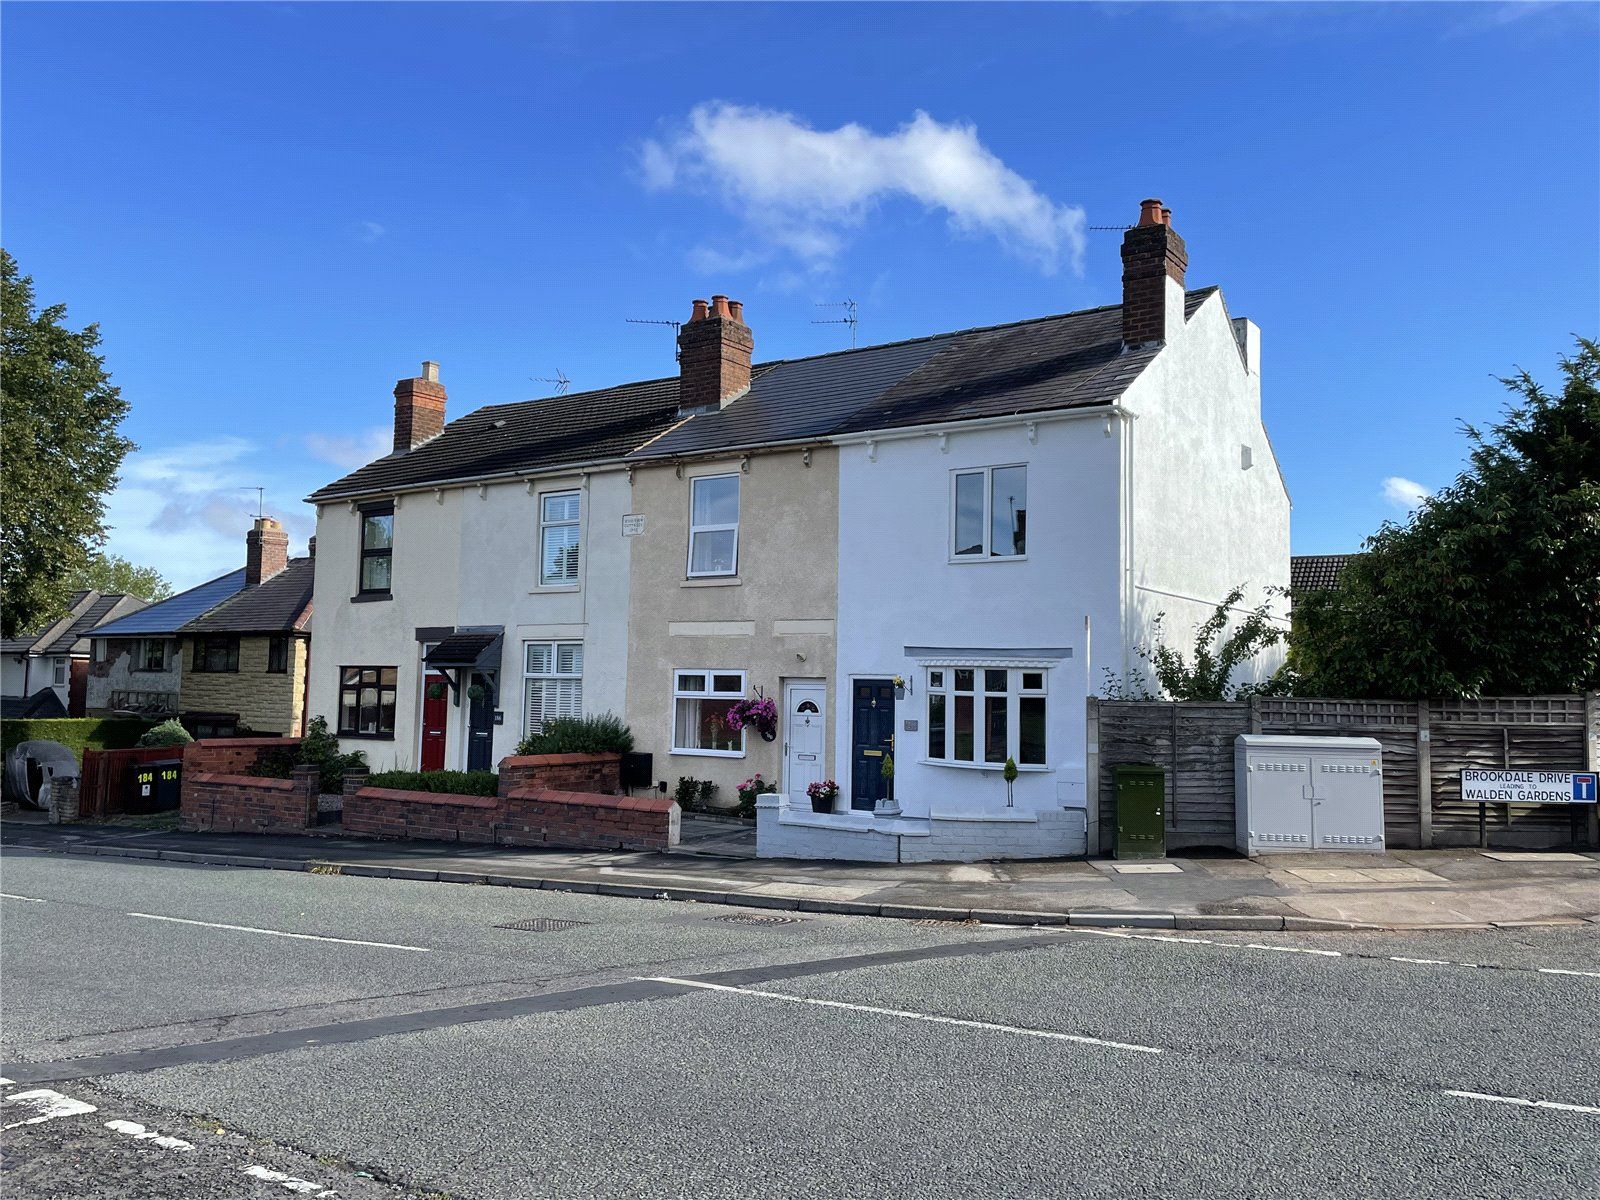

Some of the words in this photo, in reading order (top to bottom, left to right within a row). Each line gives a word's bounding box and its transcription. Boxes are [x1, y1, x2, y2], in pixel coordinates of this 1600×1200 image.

[137, 772, 153, 784] 184
[161, 770, 177, 780] 184
[1465, 771, 1534, 783] BROOKDALE
[1539, 773, 1571, 784] DRIVE
[1465, 789, 1513, 800] WALDEN
[1517, 790, 1571, 801] GARDENS
